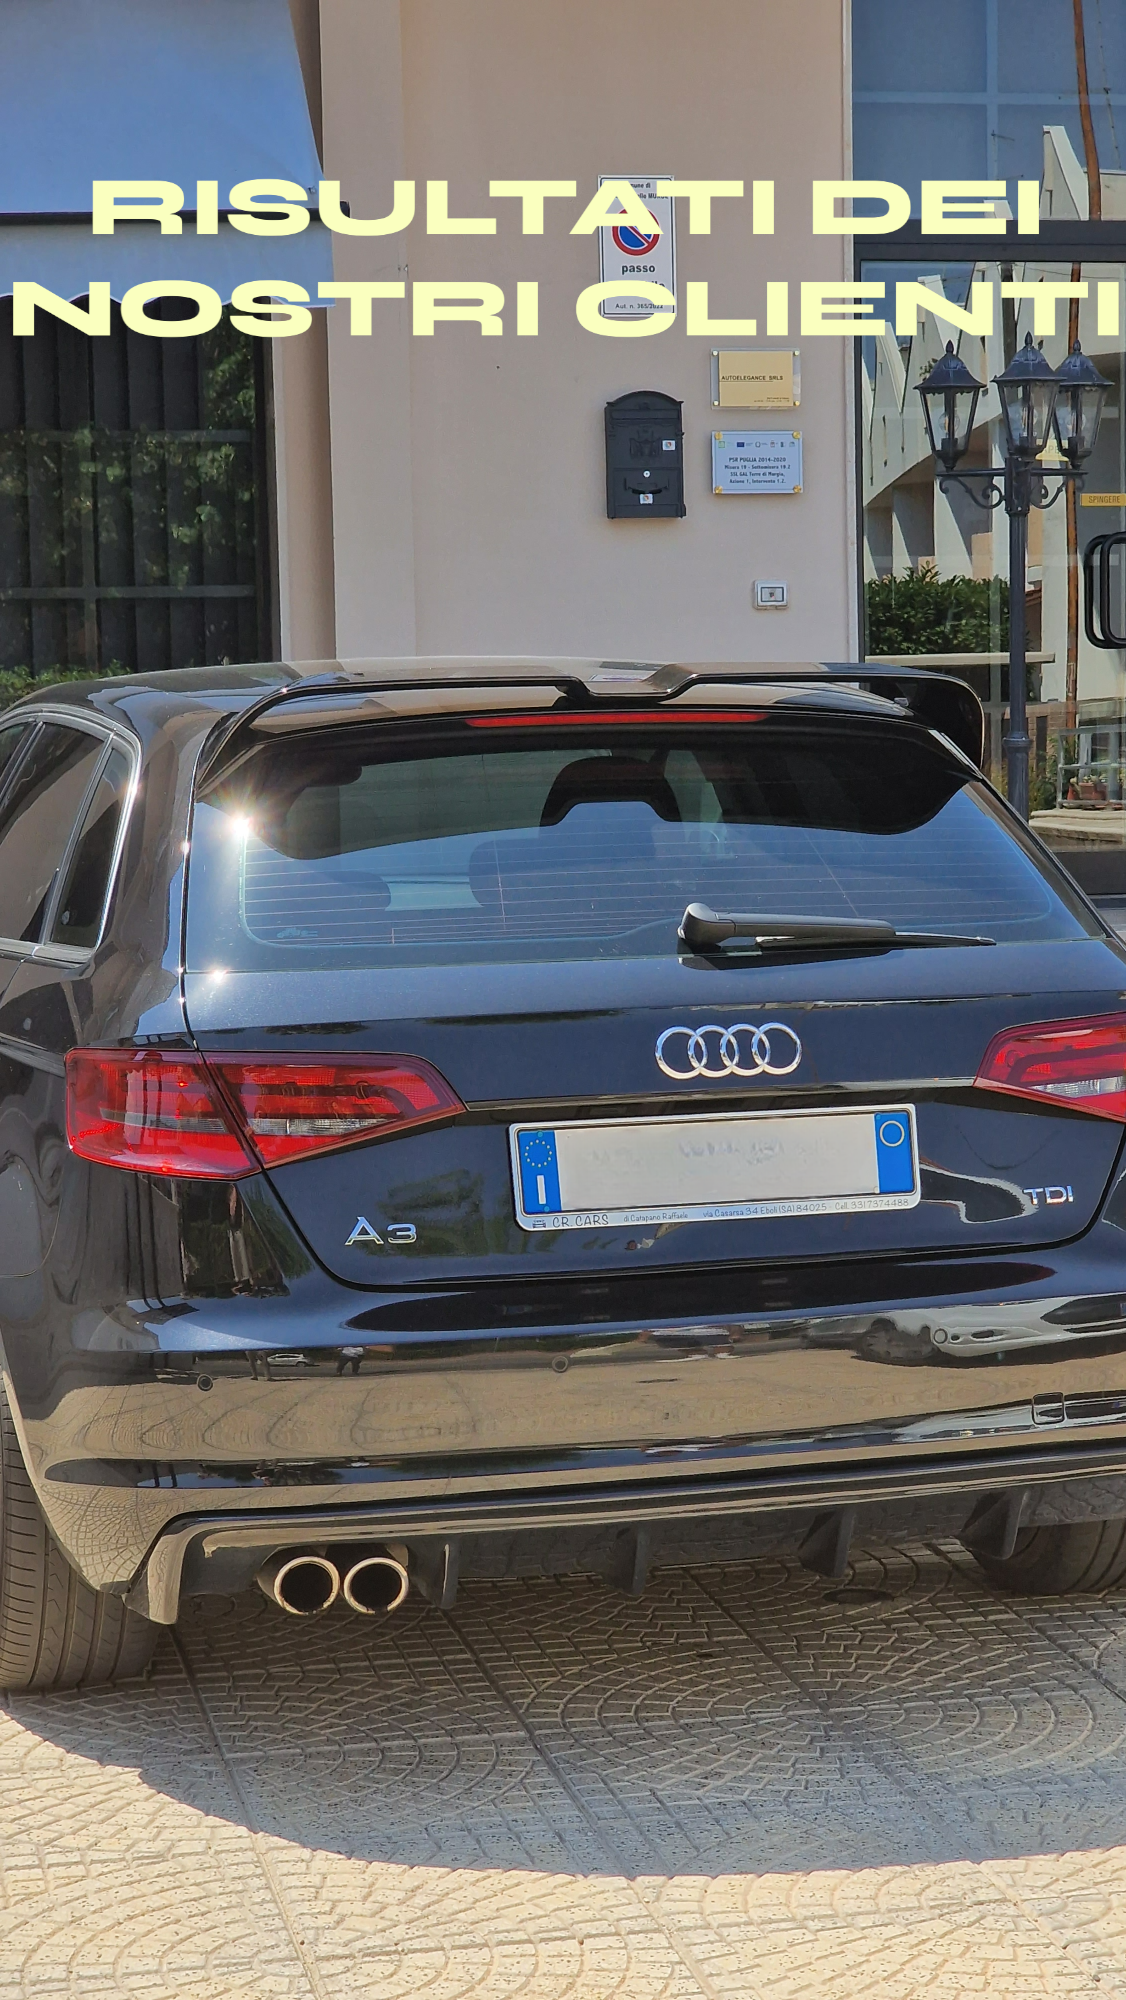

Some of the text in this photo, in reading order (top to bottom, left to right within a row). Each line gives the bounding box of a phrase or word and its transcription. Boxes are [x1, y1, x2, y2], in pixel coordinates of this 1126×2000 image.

[621, 264, 656, 276] passo
[1088, 495, 1121, 504] SPINGERE
[1023, 1185, 1074, 1205] TDI
[714, 1209, 744, 1218] Casarsa
[745, 1207, 759, 1216] 34
[850, 1198, 910, 1210] 3317374488
[552, 1214, 610, 1228] CR. CARS
[623, 1212, 689, 1223] di Catapano Raffaele
[344, 1216, 417, 1246] A3
